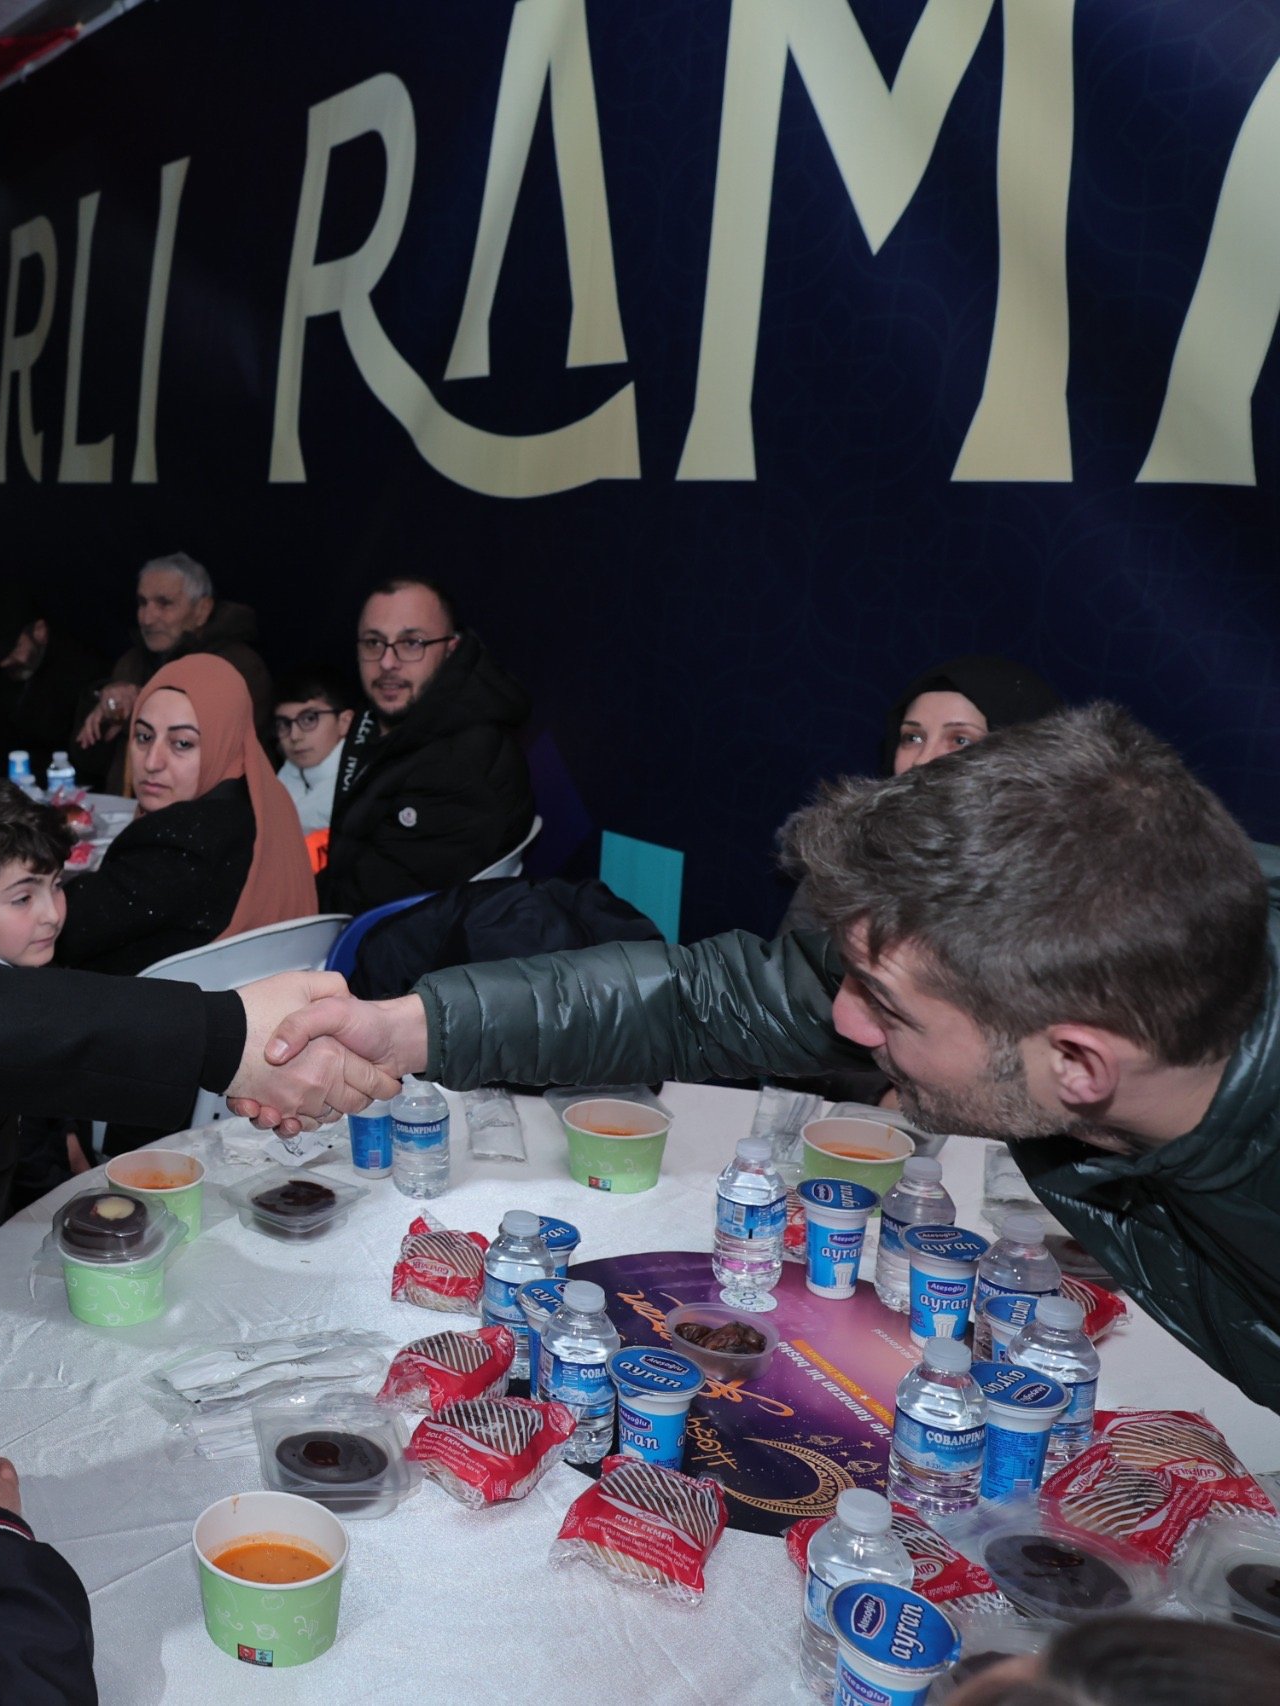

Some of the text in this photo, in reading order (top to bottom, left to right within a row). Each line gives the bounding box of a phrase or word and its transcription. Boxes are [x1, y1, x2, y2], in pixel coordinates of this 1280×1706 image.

[921, 1241, 980, 1254] ayran
[930, 1282, 967, 1294] Ateşoğlu
[920, 1294, 970, 1313] ayran
[777, 1341, 811, 1368] başka
[580, 1367, 608, 1381] ÇOBA
[619, 1361, 683, 1389] ayran
[805, 1369, 827, 1381] bir
[983, 1369, 1026, 1394] ayran
[821, 1381, 875, 1422] Ramazan
[620, 1424, 659, 1450] yran
[926, 1429, 986, 1445] ÇOBANPINA
[615, 1514, 639, 1528] ROLL
[640, 1524, 674, 1542] EKMEK
[856, 1598, 876, 1633] Ateşoğlu
[890, 1602, 925, 1662] ayran
[842, 1669, 885, 1702] Ateşoğlu
